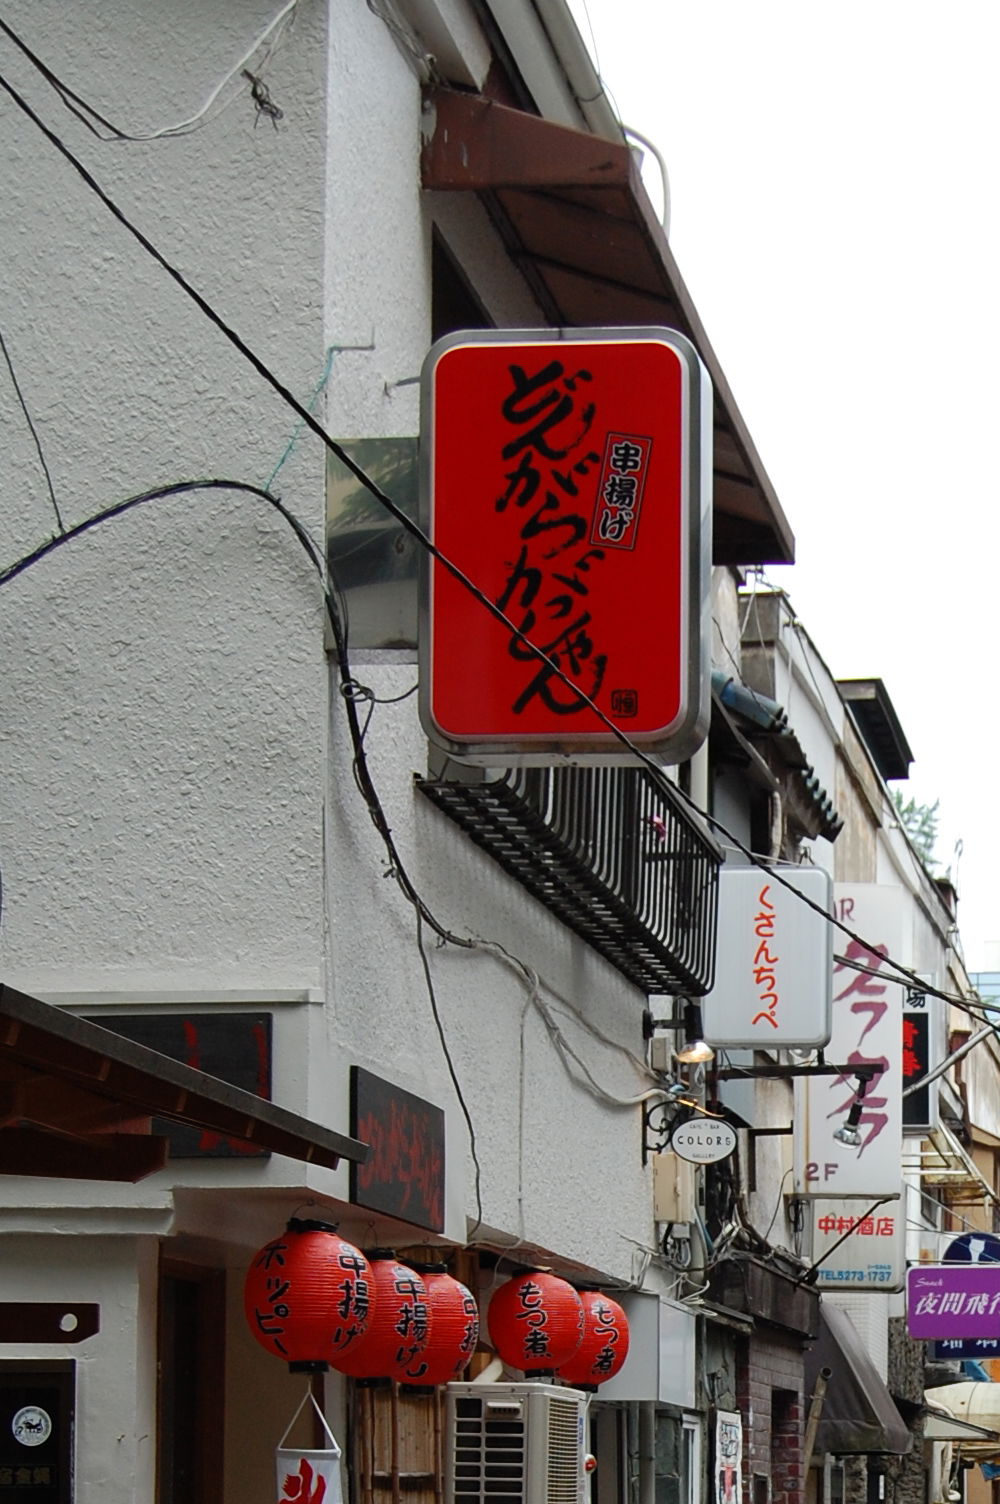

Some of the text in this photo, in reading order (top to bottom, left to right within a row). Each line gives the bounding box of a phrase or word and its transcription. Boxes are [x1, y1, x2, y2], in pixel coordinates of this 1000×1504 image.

[598, 440, 644, 543] 串揚げ
[752, 885, 780, 1029] くさんちっぺ
[677, 1135, 732, 1146] COLORS
[805, 1163, 840, 1183] 2F
[818, 1215, 895, 1236] 中村酒店
[336, 1244, 371, 1352] 串揚げ
[515, 1281, 553, 1360] もつ煮
[591, 1299, 619, 1376] もつ煮
